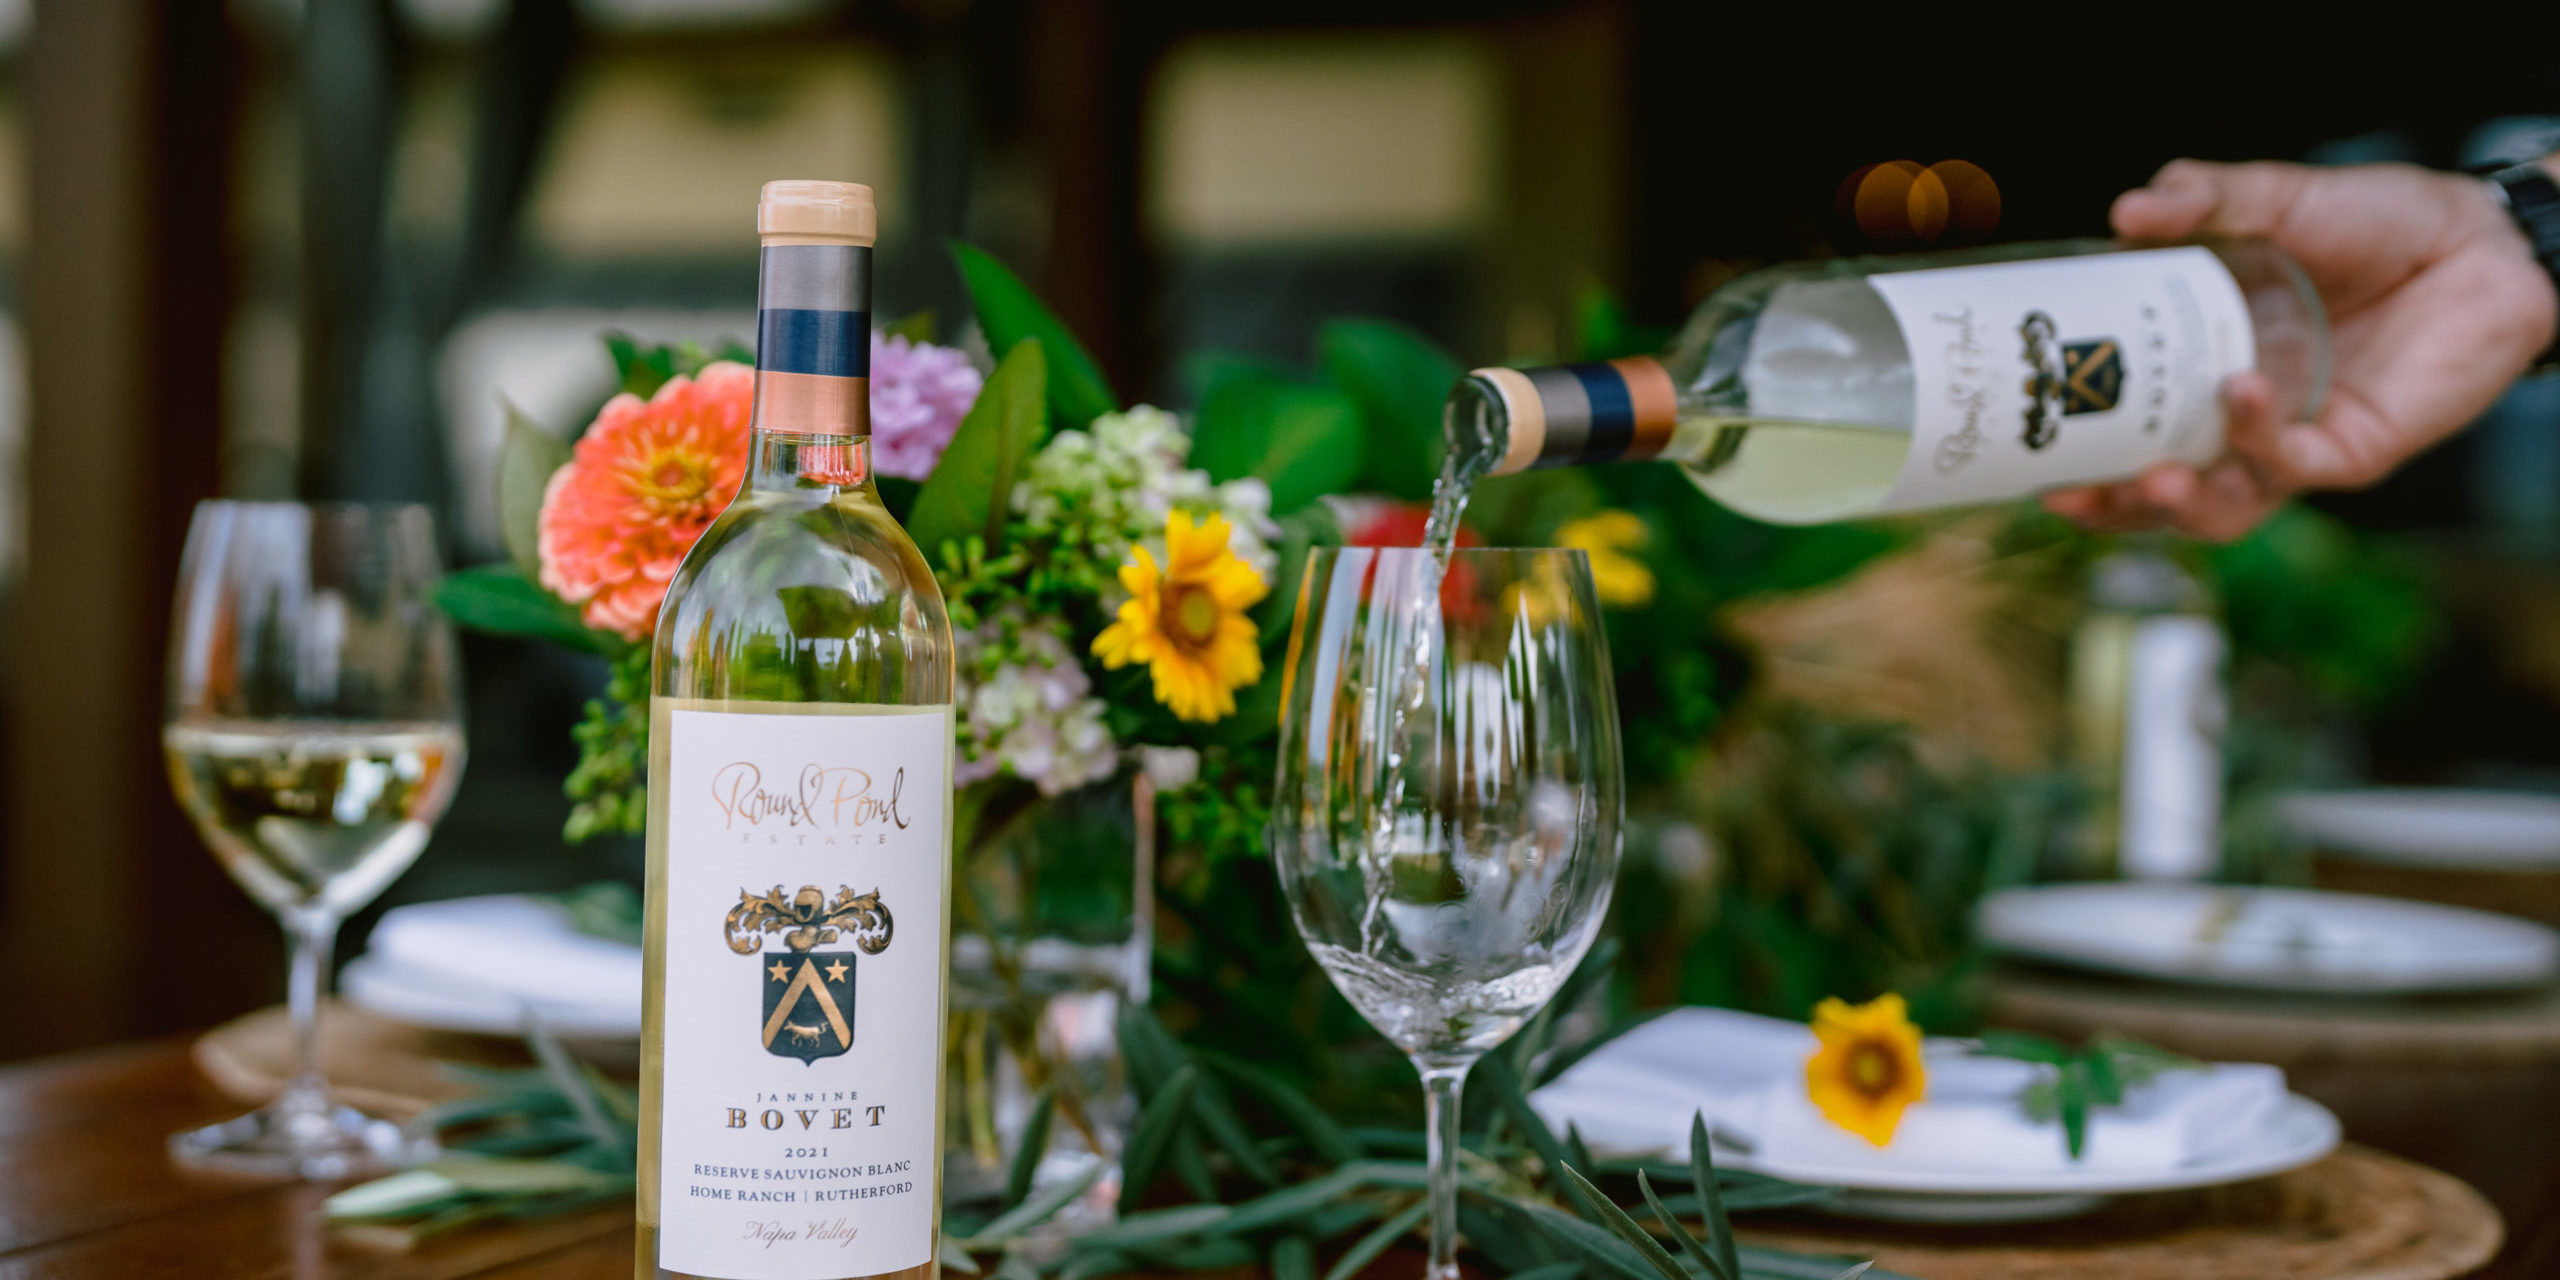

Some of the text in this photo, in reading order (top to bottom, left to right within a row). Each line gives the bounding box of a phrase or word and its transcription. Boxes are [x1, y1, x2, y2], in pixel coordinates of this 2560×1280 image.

[712, 762, 911, 830] Round Pond
[743, 833, 886, 845] ESTATE
[757, 1091, 858, 1103] JANNINE
[726, 1105, 885, 1130] BOVET
[784, 1147, 828, 1158] 2021
[694, 1160, 911, 1181] RESERVE SAUVIGNON BLANC
[690, 1185, 732, 1200] HOME
[738, 1191, 795, 1203] RANCH
[815, 1181, 913, 1202] RUTHERFORD
[742, 1217, 859, 1249] Napa Valley
